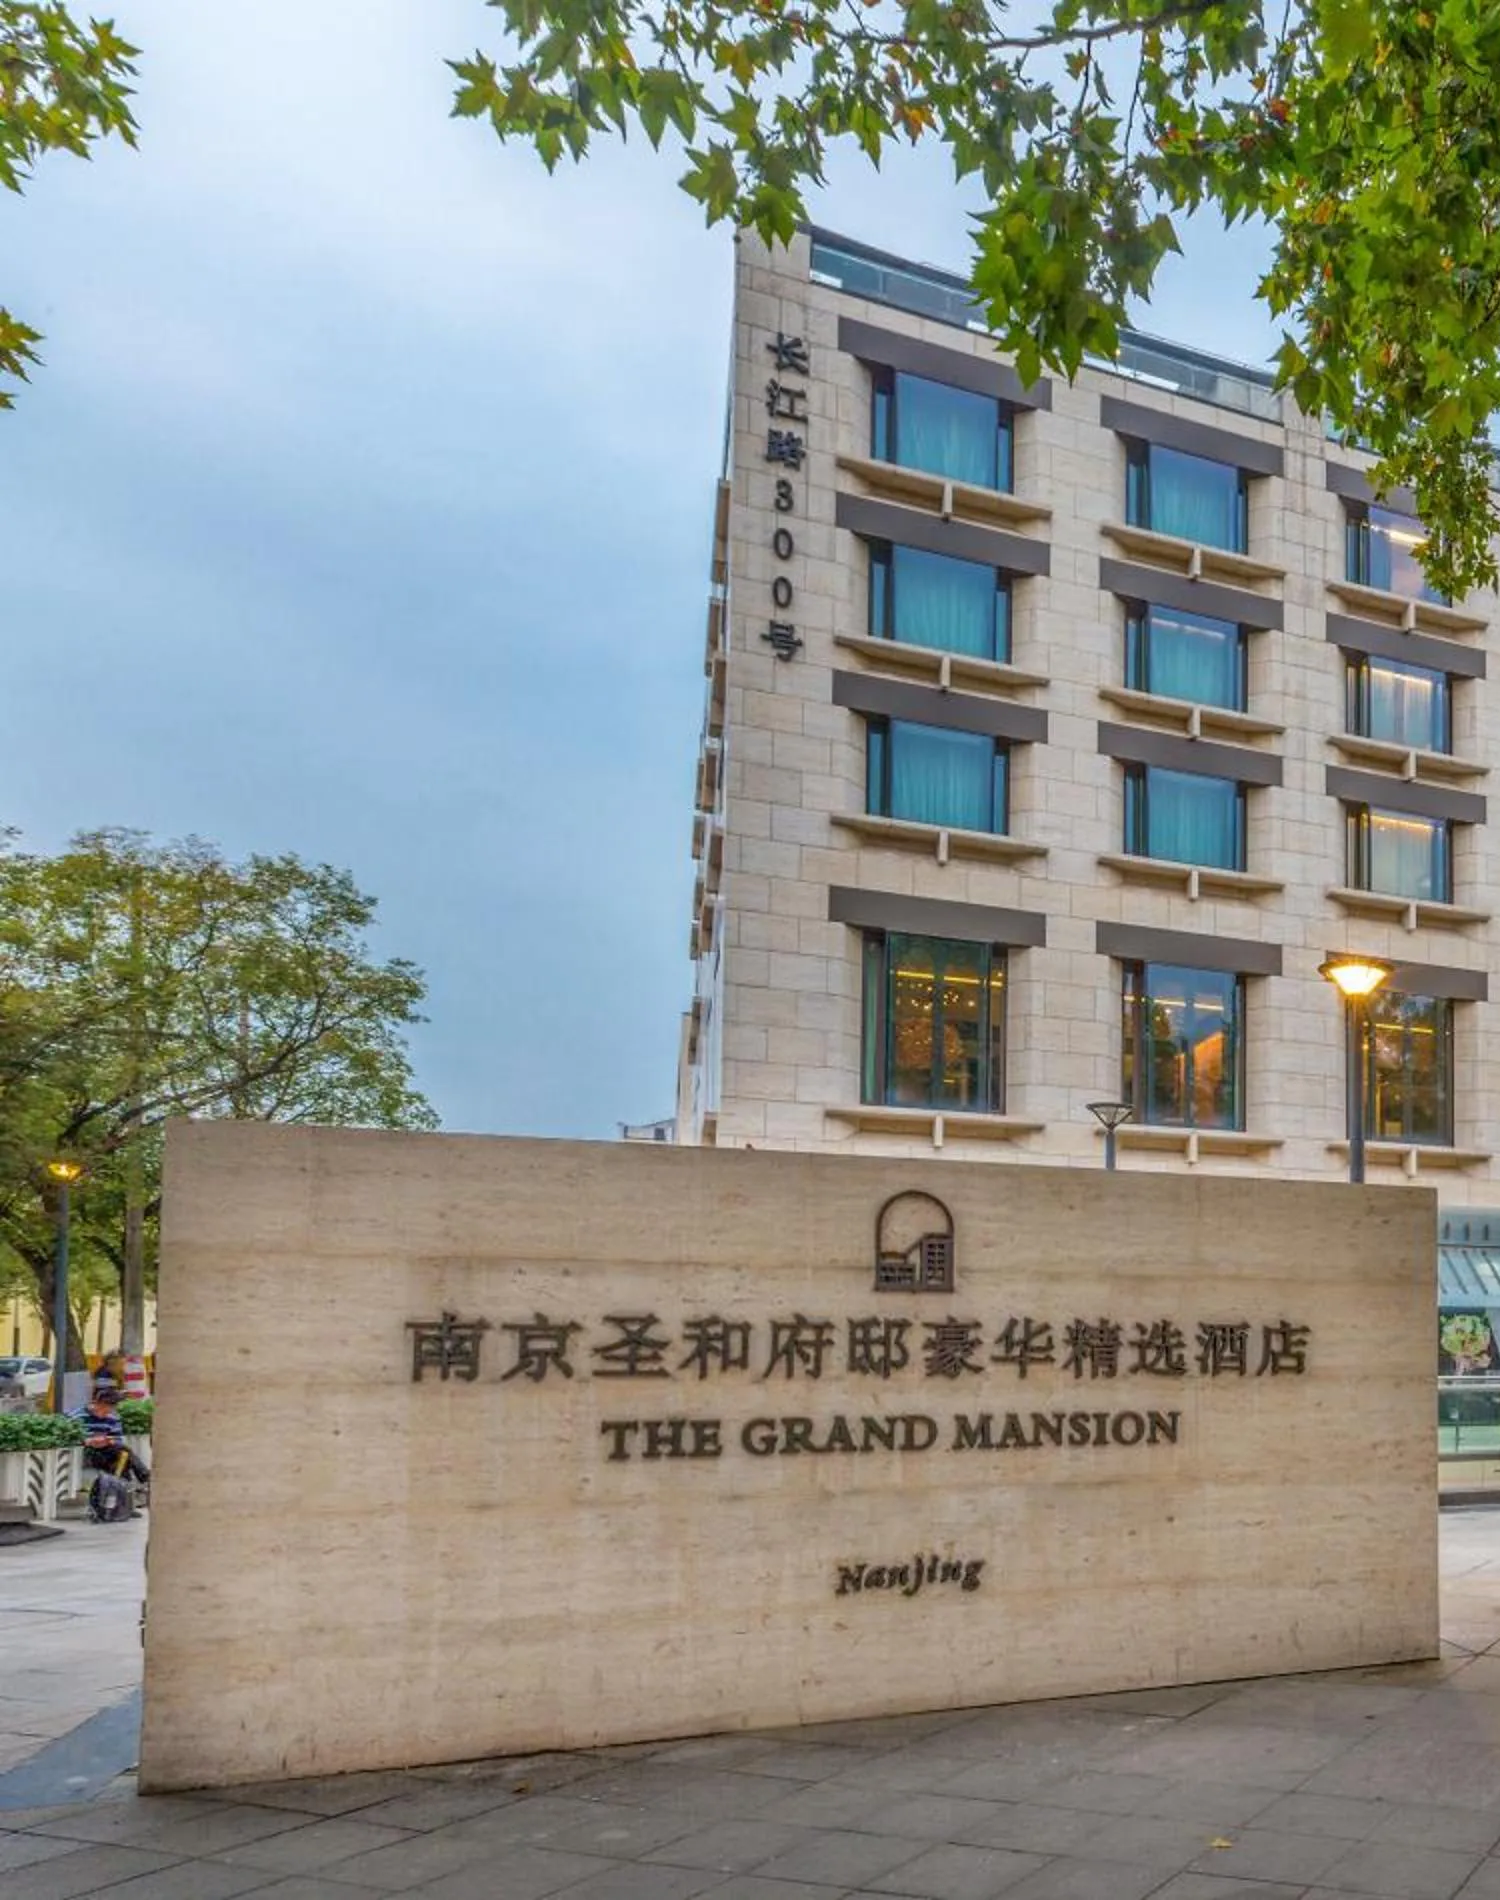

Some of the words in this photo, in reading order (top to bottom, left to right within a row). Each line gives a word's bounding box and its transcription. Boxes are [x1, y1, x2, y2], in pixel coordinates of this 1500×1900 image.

[760, 331, 810, 662] 长江路300号
[404, 1312, 1312, 1382] 南京圣和府邸豪华精选酒店
[601, 1419, 723, 1460] THE
[740, 1415, 938, 1456] GRAND
[951, 1411, 1181, 1451] MANSION
[835, 1551, 986, 1597] Nanjing
